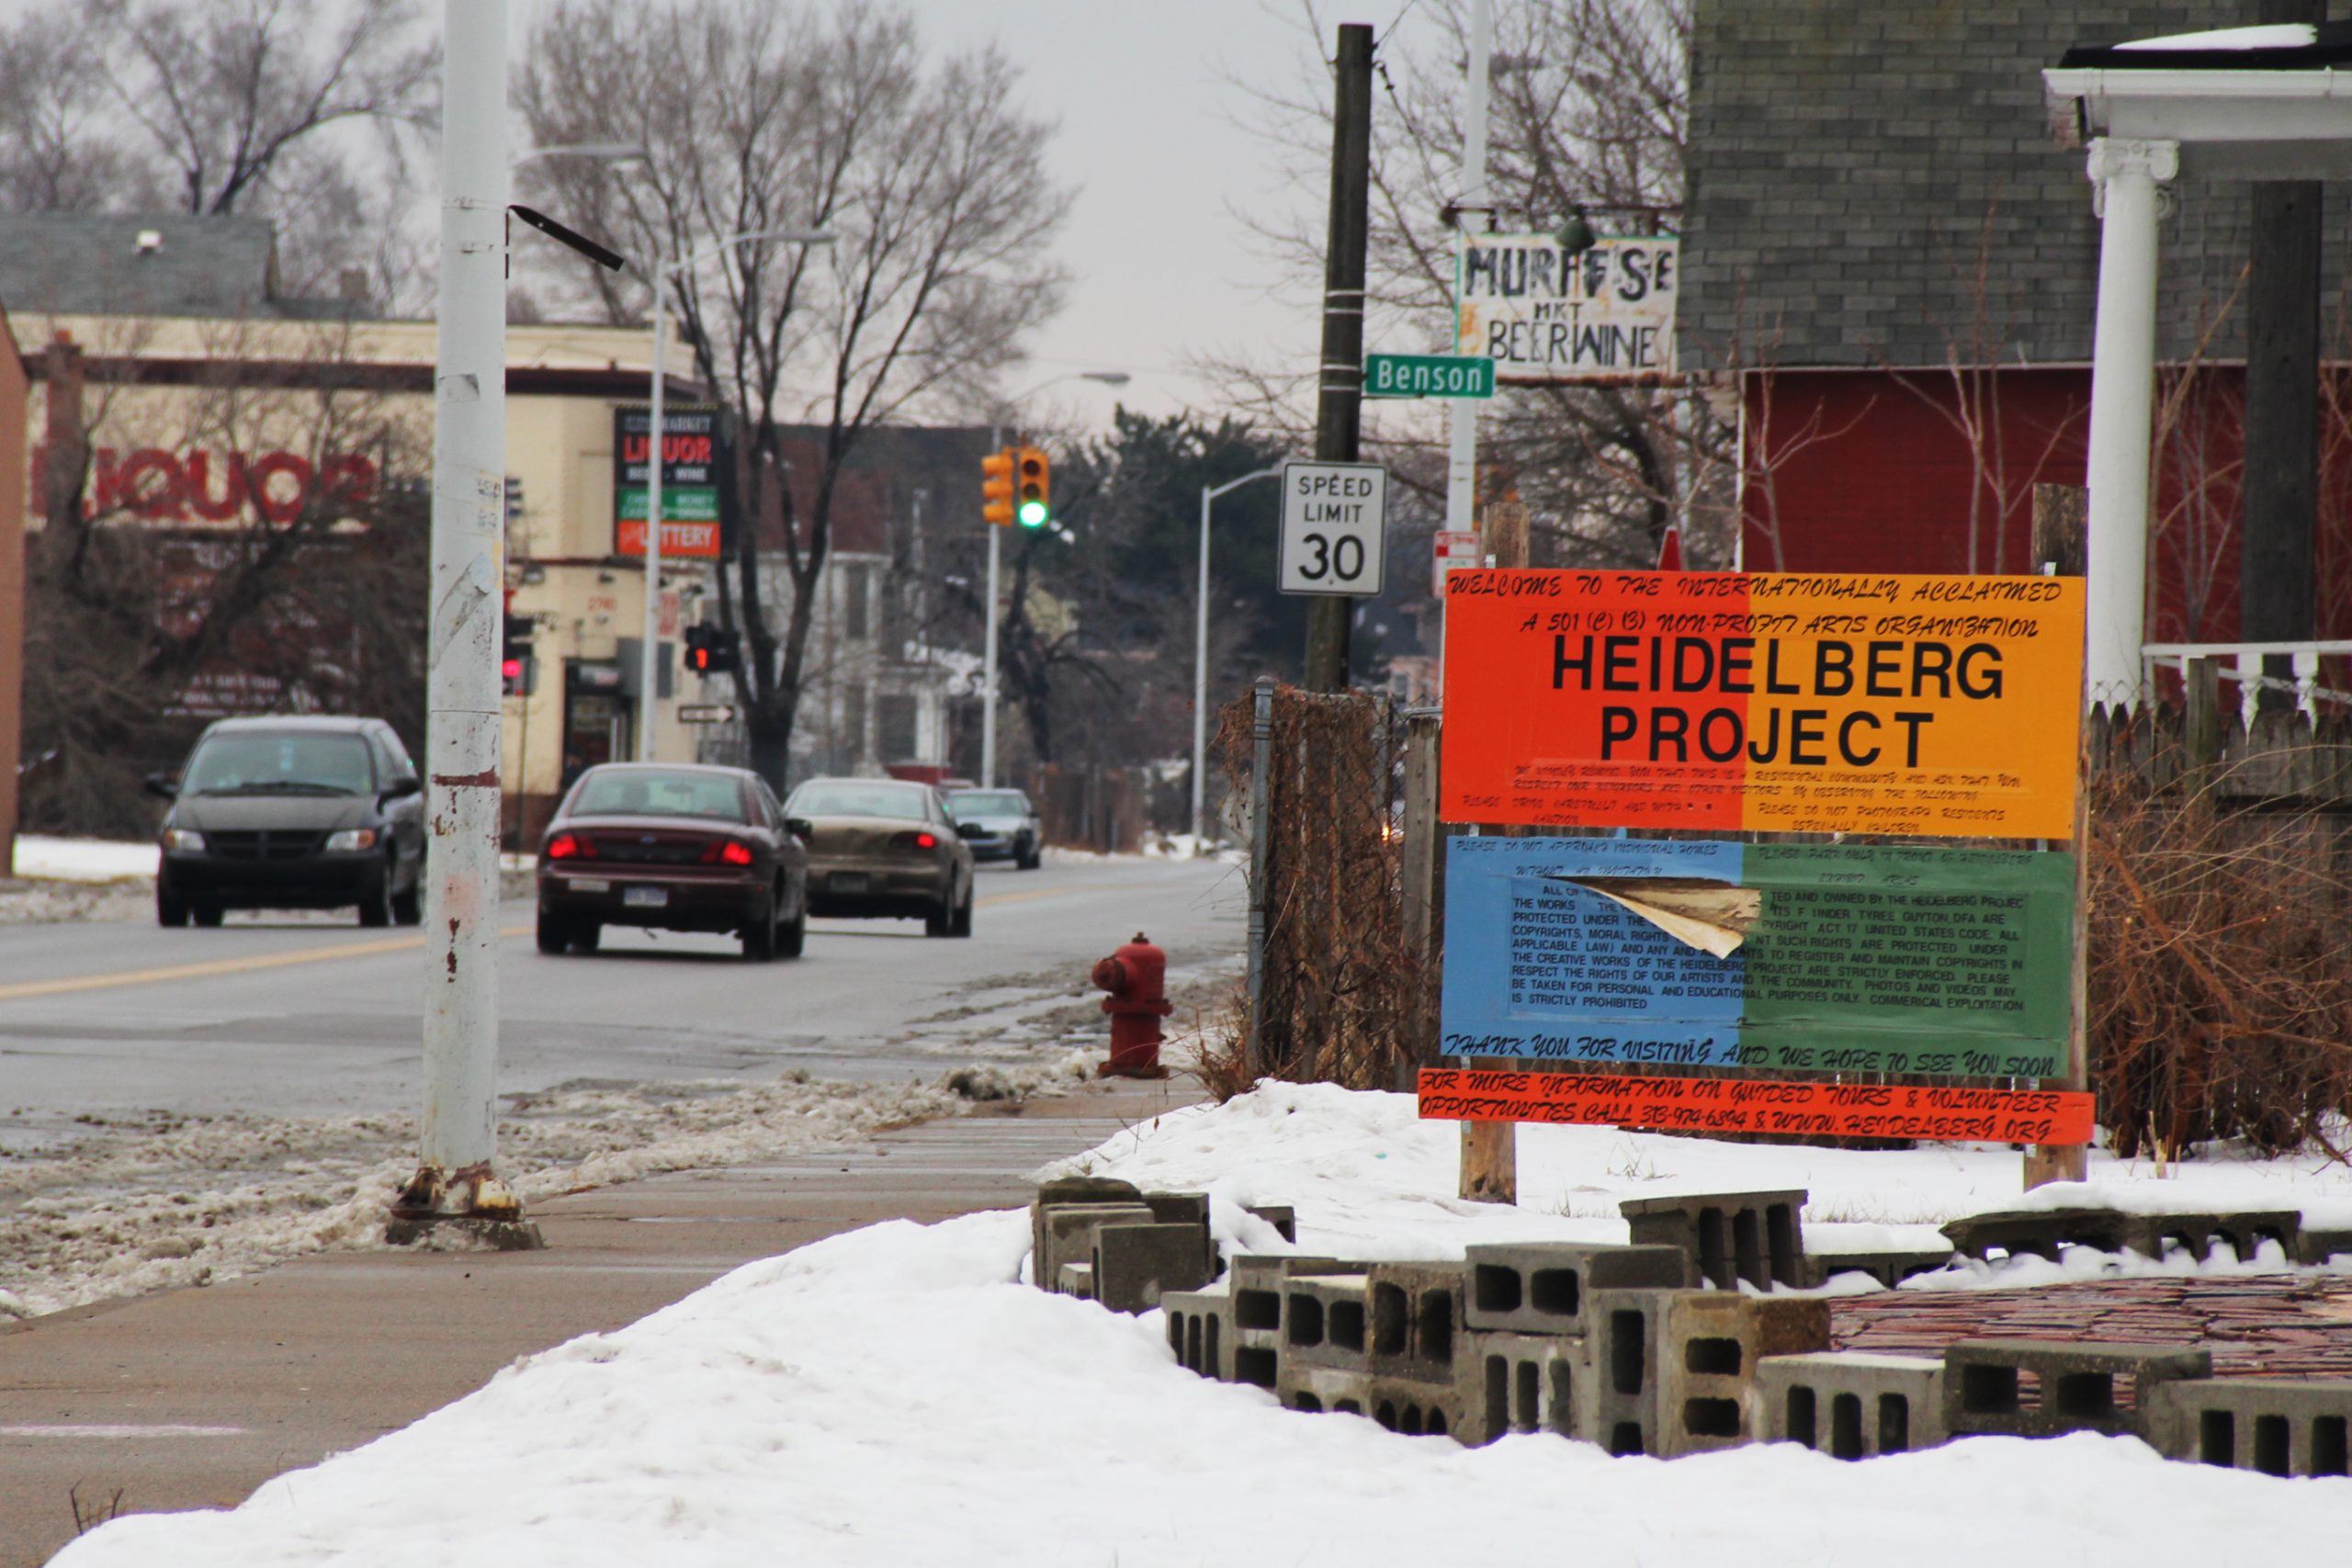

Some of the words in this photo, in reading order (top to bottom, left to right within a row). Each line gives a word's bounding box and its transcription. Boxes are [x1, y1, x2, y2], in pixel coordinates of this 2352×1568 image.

[1534, 302, 1583, 320] MKT
[1488, 321, 1567, 364] BEER
[1572, 323, 1659, 367] WINE
[1378, 359, 1483, 393] Benson
[624, 435, 712, 463] LIUOR
[1298, 475, 1373, 497] SPEED
[1304, 503, 1363, 523] LIMIT
[639, 525, 713, 548] LTTERY
[1299, 533, 1364, 581] 30
[1449, 575, 1562, 596] WELCOME
[1577, 576, 1602, 595] TO
[1617, 576, 1662, 596] THE
[1677, 576, 1901, 602] INTERNATIONALLY
[1912, 582, 2062, 602] ACCLAIMED
[1520, 613, 1539, 631] A
[1547, 613, 1578, 631] 501
[1588, 612, 1612, 631] (C)
[1657, 613, 1798, 634] NON-PROFIT
[1803, 615, 1867, 635] ARTS
[1876, 616, 2039, 637] ORGANIZATION
[1553, 636, 2004, 699] HEIDELBERG
[1601, 705, 1934, 768] PROJECT
[1514, 898, 1532, 908] THE
[1537, 899, 1575, 909] WORKS
[1598, 902, 1616, 912] THE
[1860, 910, 1895, 921] TYREE
[1982, 914, 2005, 924] ARE
[1544, 886, 1562, 896] ALL
[1795, 893, 1817, 902] AND
[1824, 893, 1866, 903] OWNED
[1870, 894, 1883, 904] BY
[1888, 895, 1907, 905] THE
[1911, 896, 1976, 907] HEIDELBERG
[1512, 926, 1582, 940] COPYRIGHTS,
[1589, 929, 1626, 941] MORAL
[1631, 931, 1668, 942] RIGHTS
[1777, 936, 1806, 947] SUCH
[1810, 937, 1851, 949] RIGHTS
[1860, 940, 1883, 950] ARE
[1891, 941, 1957, 953] PROTECTED
[1970, 944, 2007, 955] UNDER
[1513, 912, 1577, 924] PROTECTED
[1583, 914, 1619, 925] UNDER
[1627, 916, 1646, 926] THE
[1818, 923, 1840, 933] ACT
[1847, 924, 1857, 934] 17
[1866, 925, 1906, 936] UNITED
[1914, 926, 1955, 939] STATES
[1999, 930, 2018, 941] ALL
[1513, 939, 1577, 951] APPLICABLE
[1586, 942, 1614, 953] LAW)
[1621, 943, 1644, 953] AND
[1647, 944, 1668, 955] ANY
[1673, 946, 1696, 956] AND
[1771, 951, 1784, 961] TO
[1789, 952, 1844, 963] REGISTER
[1850, 953, 1872, 964] AND
[1878, 955, 1929, 965] MAINTAIN
[1937, 956, 2006, 970] COPYRIGHTS
[1513, 952, 1532, 962] THE
[1538, 953, 1586, 964] CREATIVE
[1591, 956, 1630, 966] WORKS
[1637, 957, 1651, 967] OF
[1657, 959, 1676, 968] THE
[1680, 960, 1747, 972] HEIDELBERG
[1753, 963, 1803, 975] PROJECT
[1808, 965, 1830, 976] ARE
[1838, 966, 1890, 978] STRICTLY
[1967, 973, 2009, 985] PLEASE
[1512, 965, 1558, 976] RESPECT
[1564, 968, 1583, 977] THE
[1589, 969, 1627, 980] RIGHTS
[1634, 970, 1647, 980] OF
[1653, 971, 1675, 982] OUR
[1680, 973, 1724, 983] ARTISTS
[1730, 975, 1754, 985] AND
[1761, 976, 1781, 987] THE
[1864, 980, 1910, 992] PHOTOS
[1917, 983, 1940, 994] AND
[1946, 984, 1986, 996] VIDEOS
[1994, 987, 2016, 998] MAY
[1512, 979, 1526, 989] BE
[1531, 980, 1566, 990] TAKEN
[1570, 981, 1592, 992] FOR
[1598, 983, 1654, 996] PERSONAL
[1661, 986, 1683, 997] AND
[1688, 987, 1763, 1000] EDUCATIONAL
[1768, 989, 1827, 1002] PURPOSES
[1870, 995, 1942, 1009] COMMERICAL
[1947, 998, 2023, 1011] EXPLOITATION
[1512, 993, 1521, 1003] IS
[1528, 994, 1576, 1006] STRICTLY
[1583, 997, 1647, 1009] PROHIBITED
[1445, 1035, 1527, 1055] THANK
[1531, 1035, 1571, 1055] YOU
[1577, 1037, 1615, 1057] FOR
[1622, 1038, 1713, 1065] VISITING
[1719, 1043, 1770, 1065] AND
[1779, 1046, 1816, 1066] WE
[1823, 1048, 1882, 1068] HOPE
[1887, 1051, 1908, 1069] TO
[1914, 1054, 1956, 1073] SEE
[1963, 1050, 1999, 1075] YOU
[2003, 1057, 2055, 1077] SOON
[1419, 1072, 1459, 1090] FOR
[1466, 1073, 1531, 1092] MORE
[1540, 1075, 1683, 1098] INFORMATION
[1691, 1079, 1722, 1098] ON
[1731, 1081, 1814, 1105] GUIDED
[1826, 1086, 1893, 1107] TOURS
[1905, 1088, 1917, 1107] &
[1926, 1089, 2061, 1113] VOLUNTEER
[1582, 1104, 1632, 1123] CALL
[1639, 1105, 1747, 1128] 313-974-6894
[1755, 1111, 1766, 1129] &
